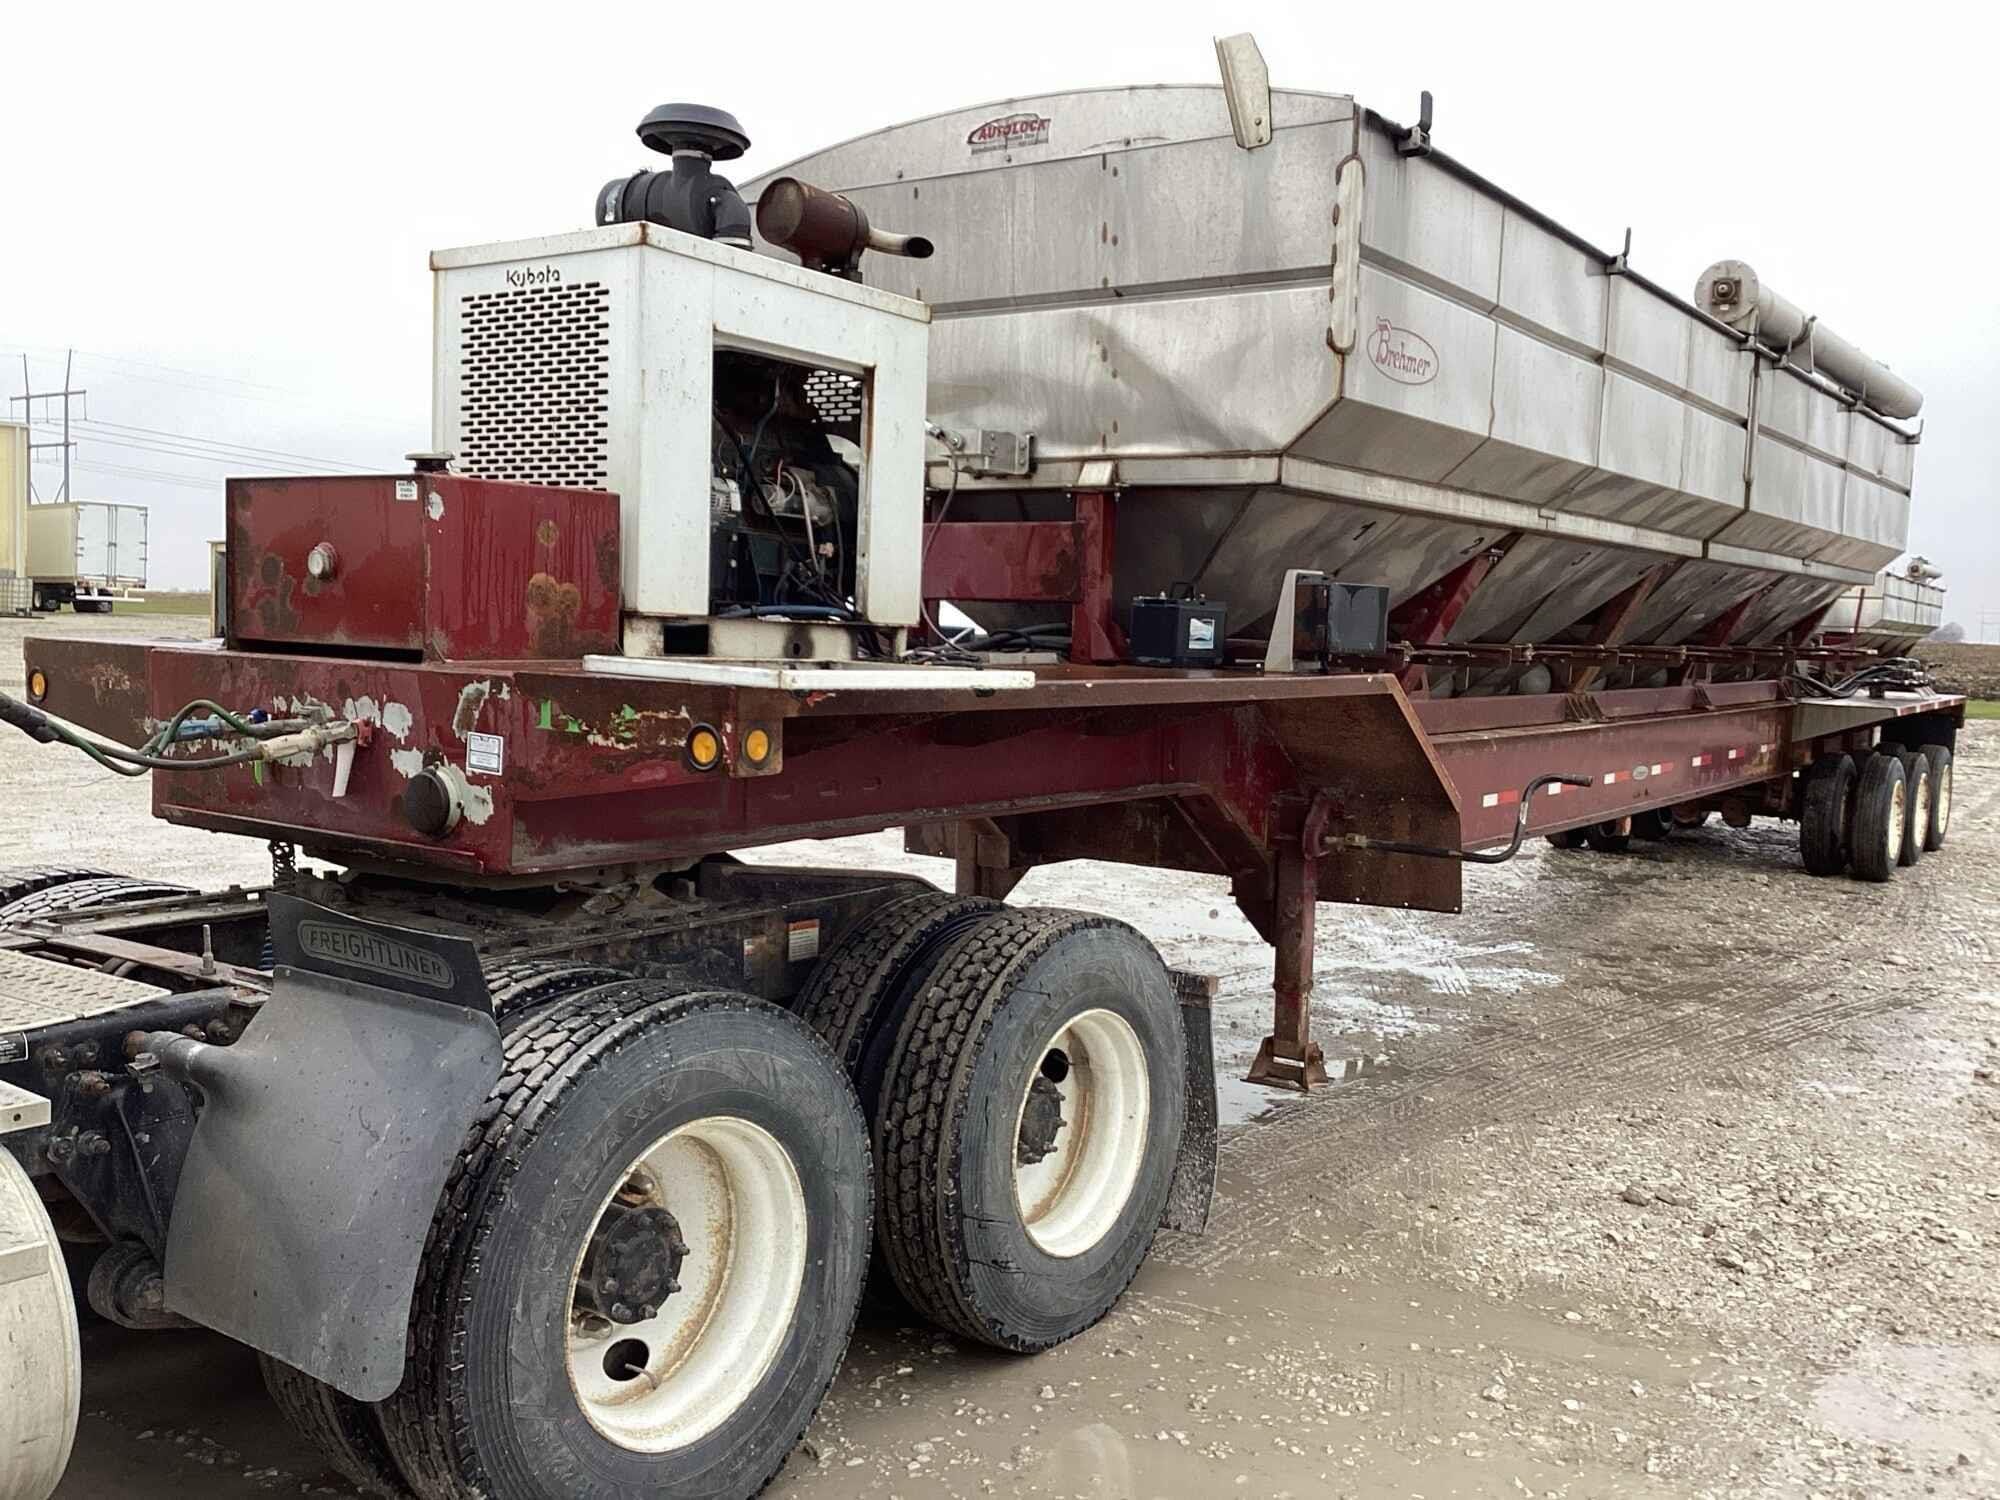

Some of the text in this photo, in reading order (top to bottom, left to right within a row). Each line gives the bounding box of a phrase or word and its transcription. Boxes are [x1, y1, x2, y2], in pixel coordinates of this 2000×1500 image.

[506, 264, 560, 287] Kubota
[1375, 316, 1431, 377] Brehmer
[310, 930, 441, 977] FREIGHTLINER
